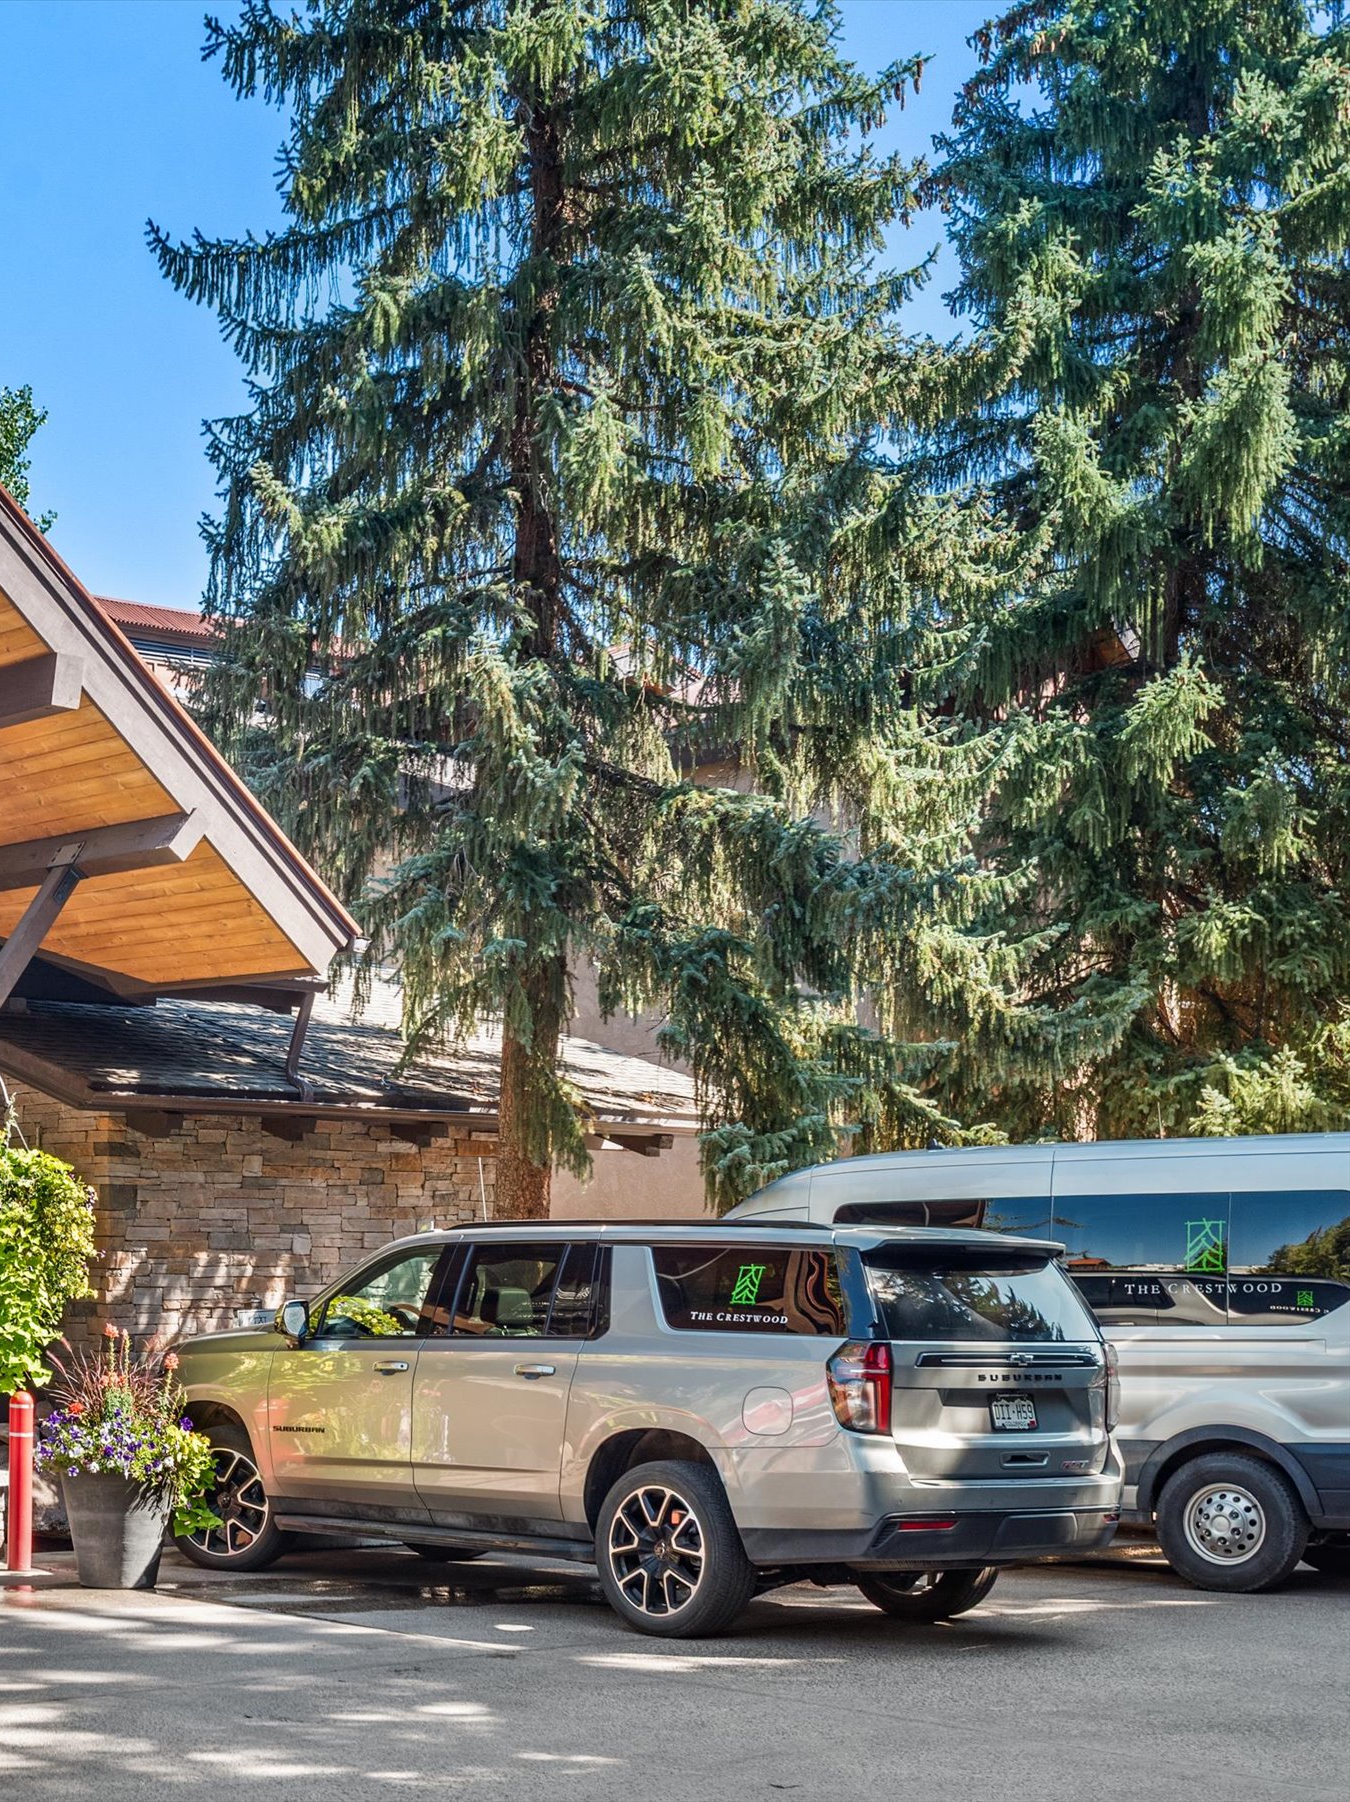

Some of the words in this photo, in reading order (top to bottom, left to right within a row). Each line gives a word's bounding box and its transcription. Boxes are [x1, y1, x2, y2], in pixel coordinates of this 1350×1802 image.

[1124, 1283, 1161, 1295] THE
[1167, 1282, 1283, 1294] CRESTWOOD
[690, 1311, 713, 1321] THE
[716, 1312, 789, 1324] CRESTWOOD
[977, 1374, 1063, 1382] SUBURBAN
[272, 1425, 325, 1433] SUBURBAN
